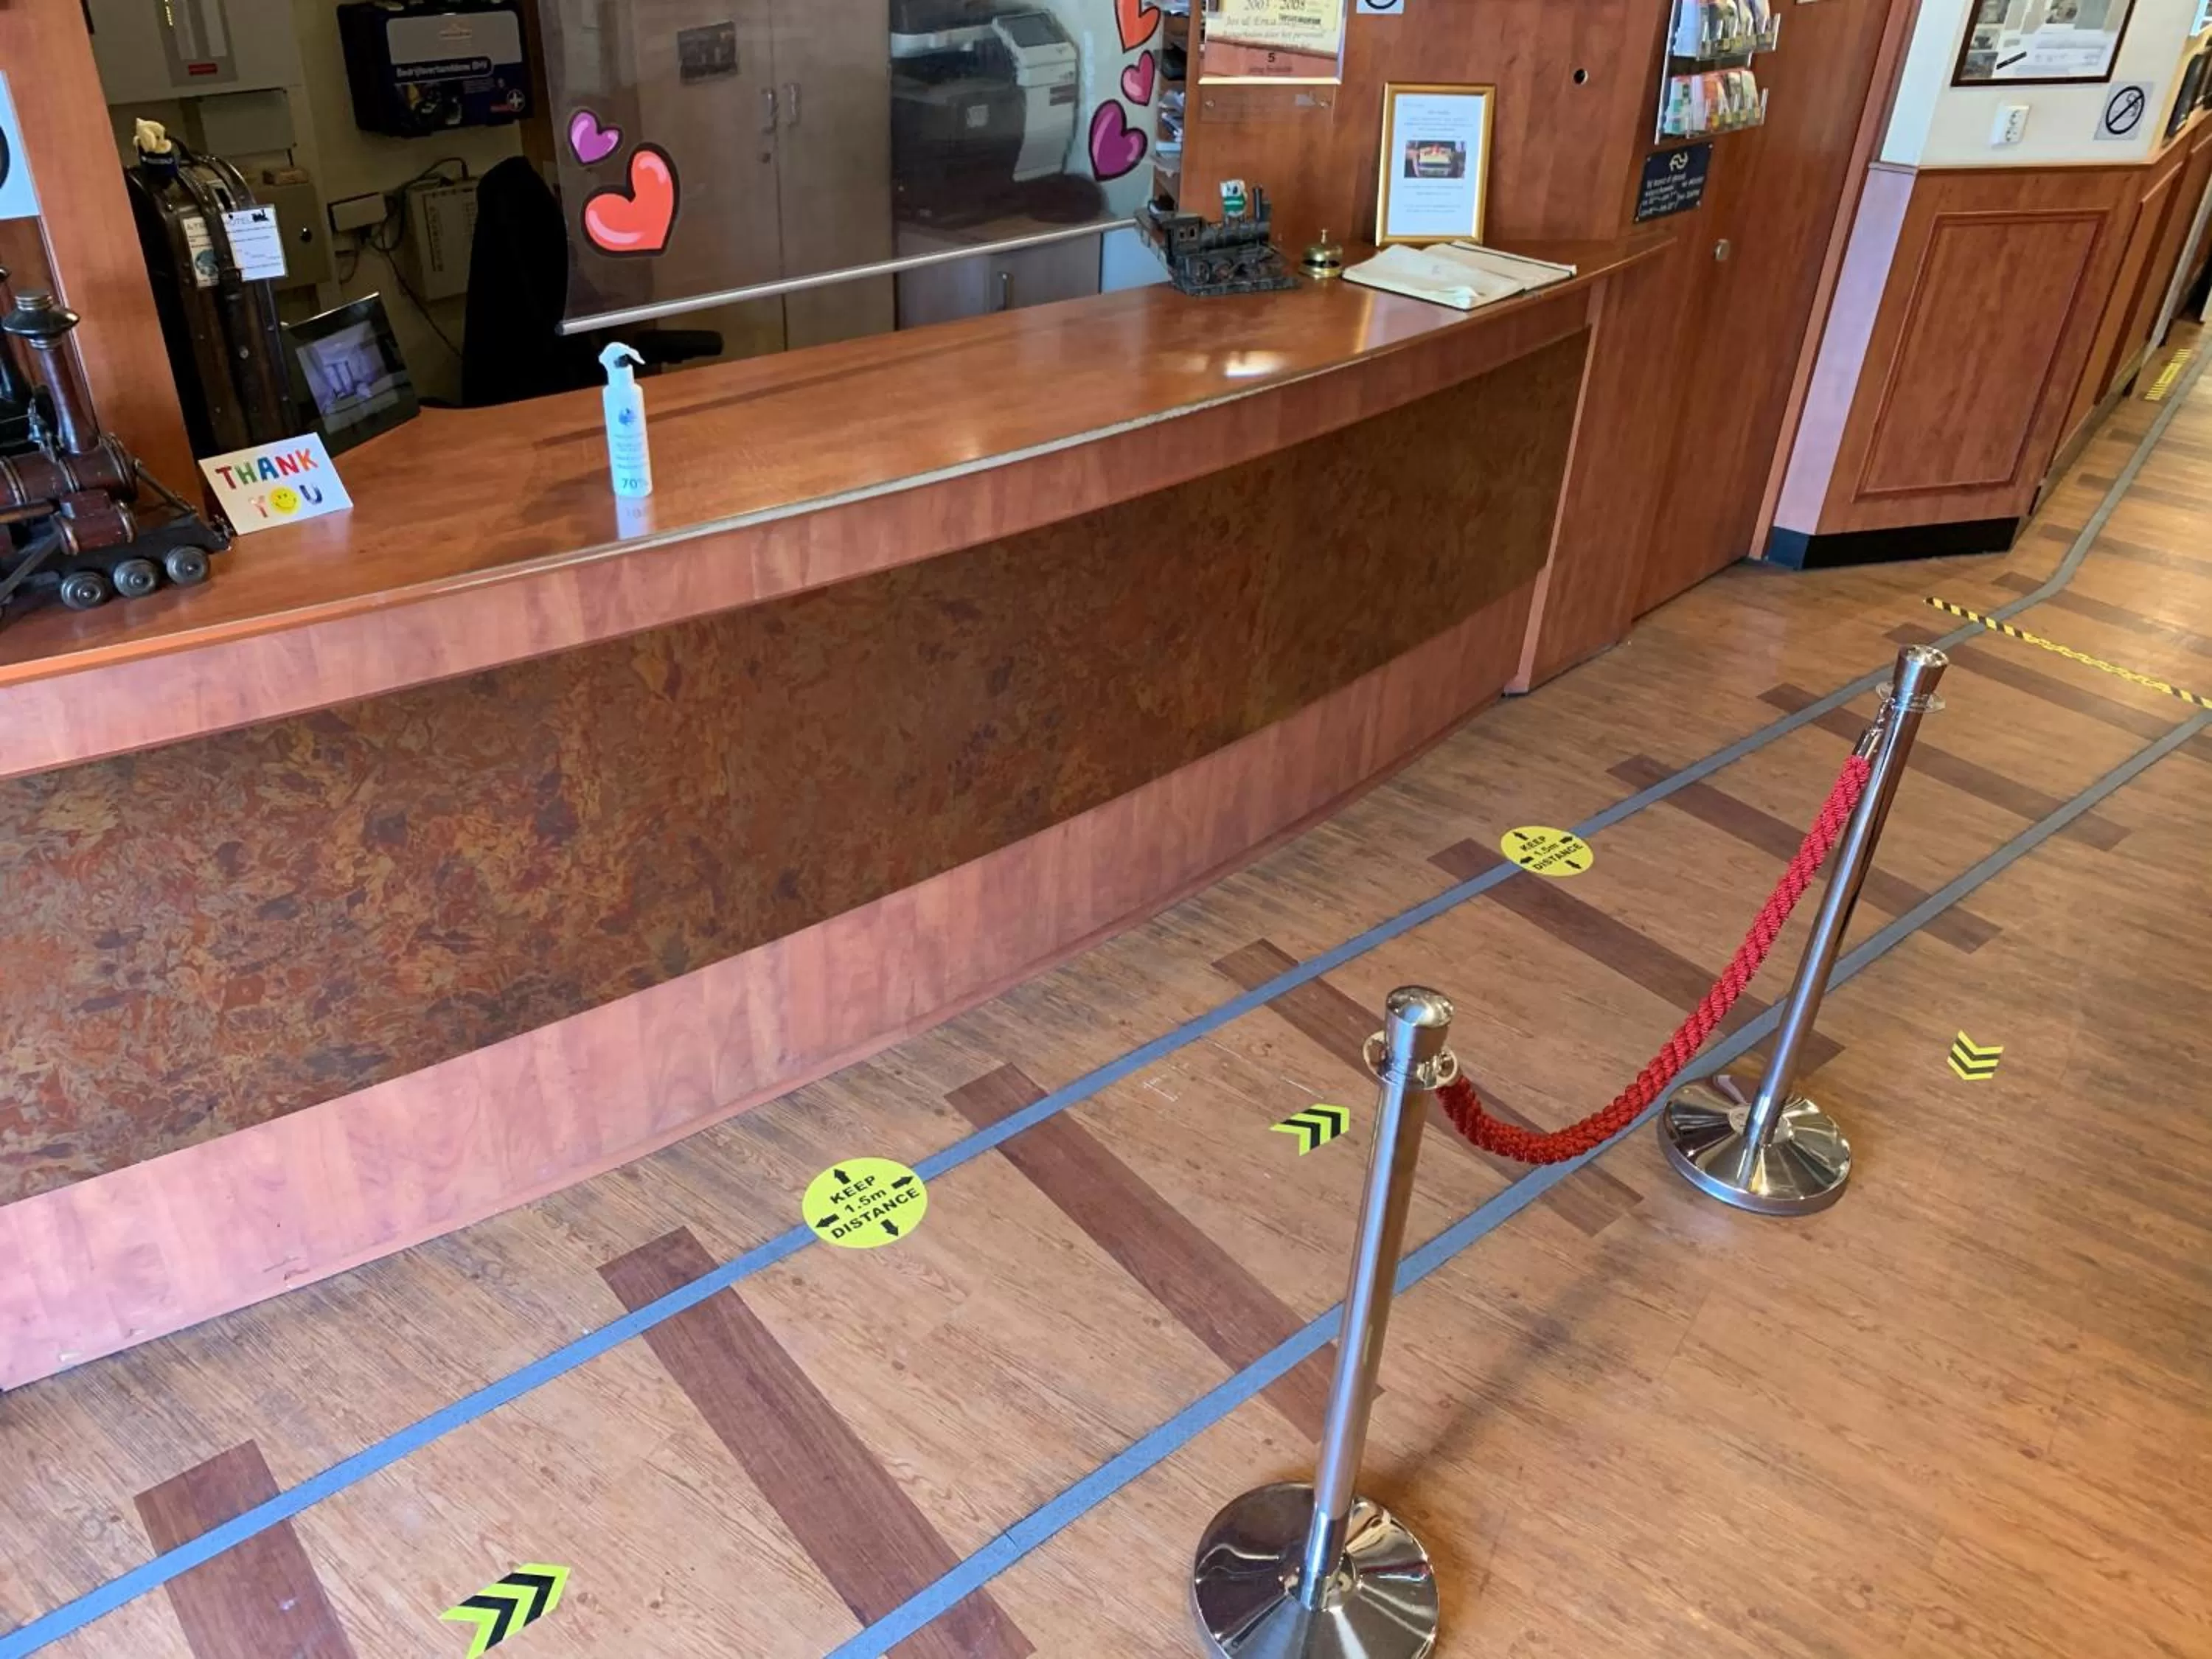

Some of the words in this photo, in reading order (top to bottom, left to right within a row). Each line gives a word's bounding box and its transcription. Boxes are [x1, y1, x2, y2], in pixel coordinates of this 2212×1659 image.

[1267, 52, 1276, 63] 5
[215, 448, 319, 490] THANK
[1520, 835, 1545, 852] KEEP
[1533, 843, 1584, 870] DISTANCE
[830, 1175, 876, 1204] KEEP
[844, 1189, 887, 1213] 1.5m
[831, 1188, 921, 1239] DISTANCE
